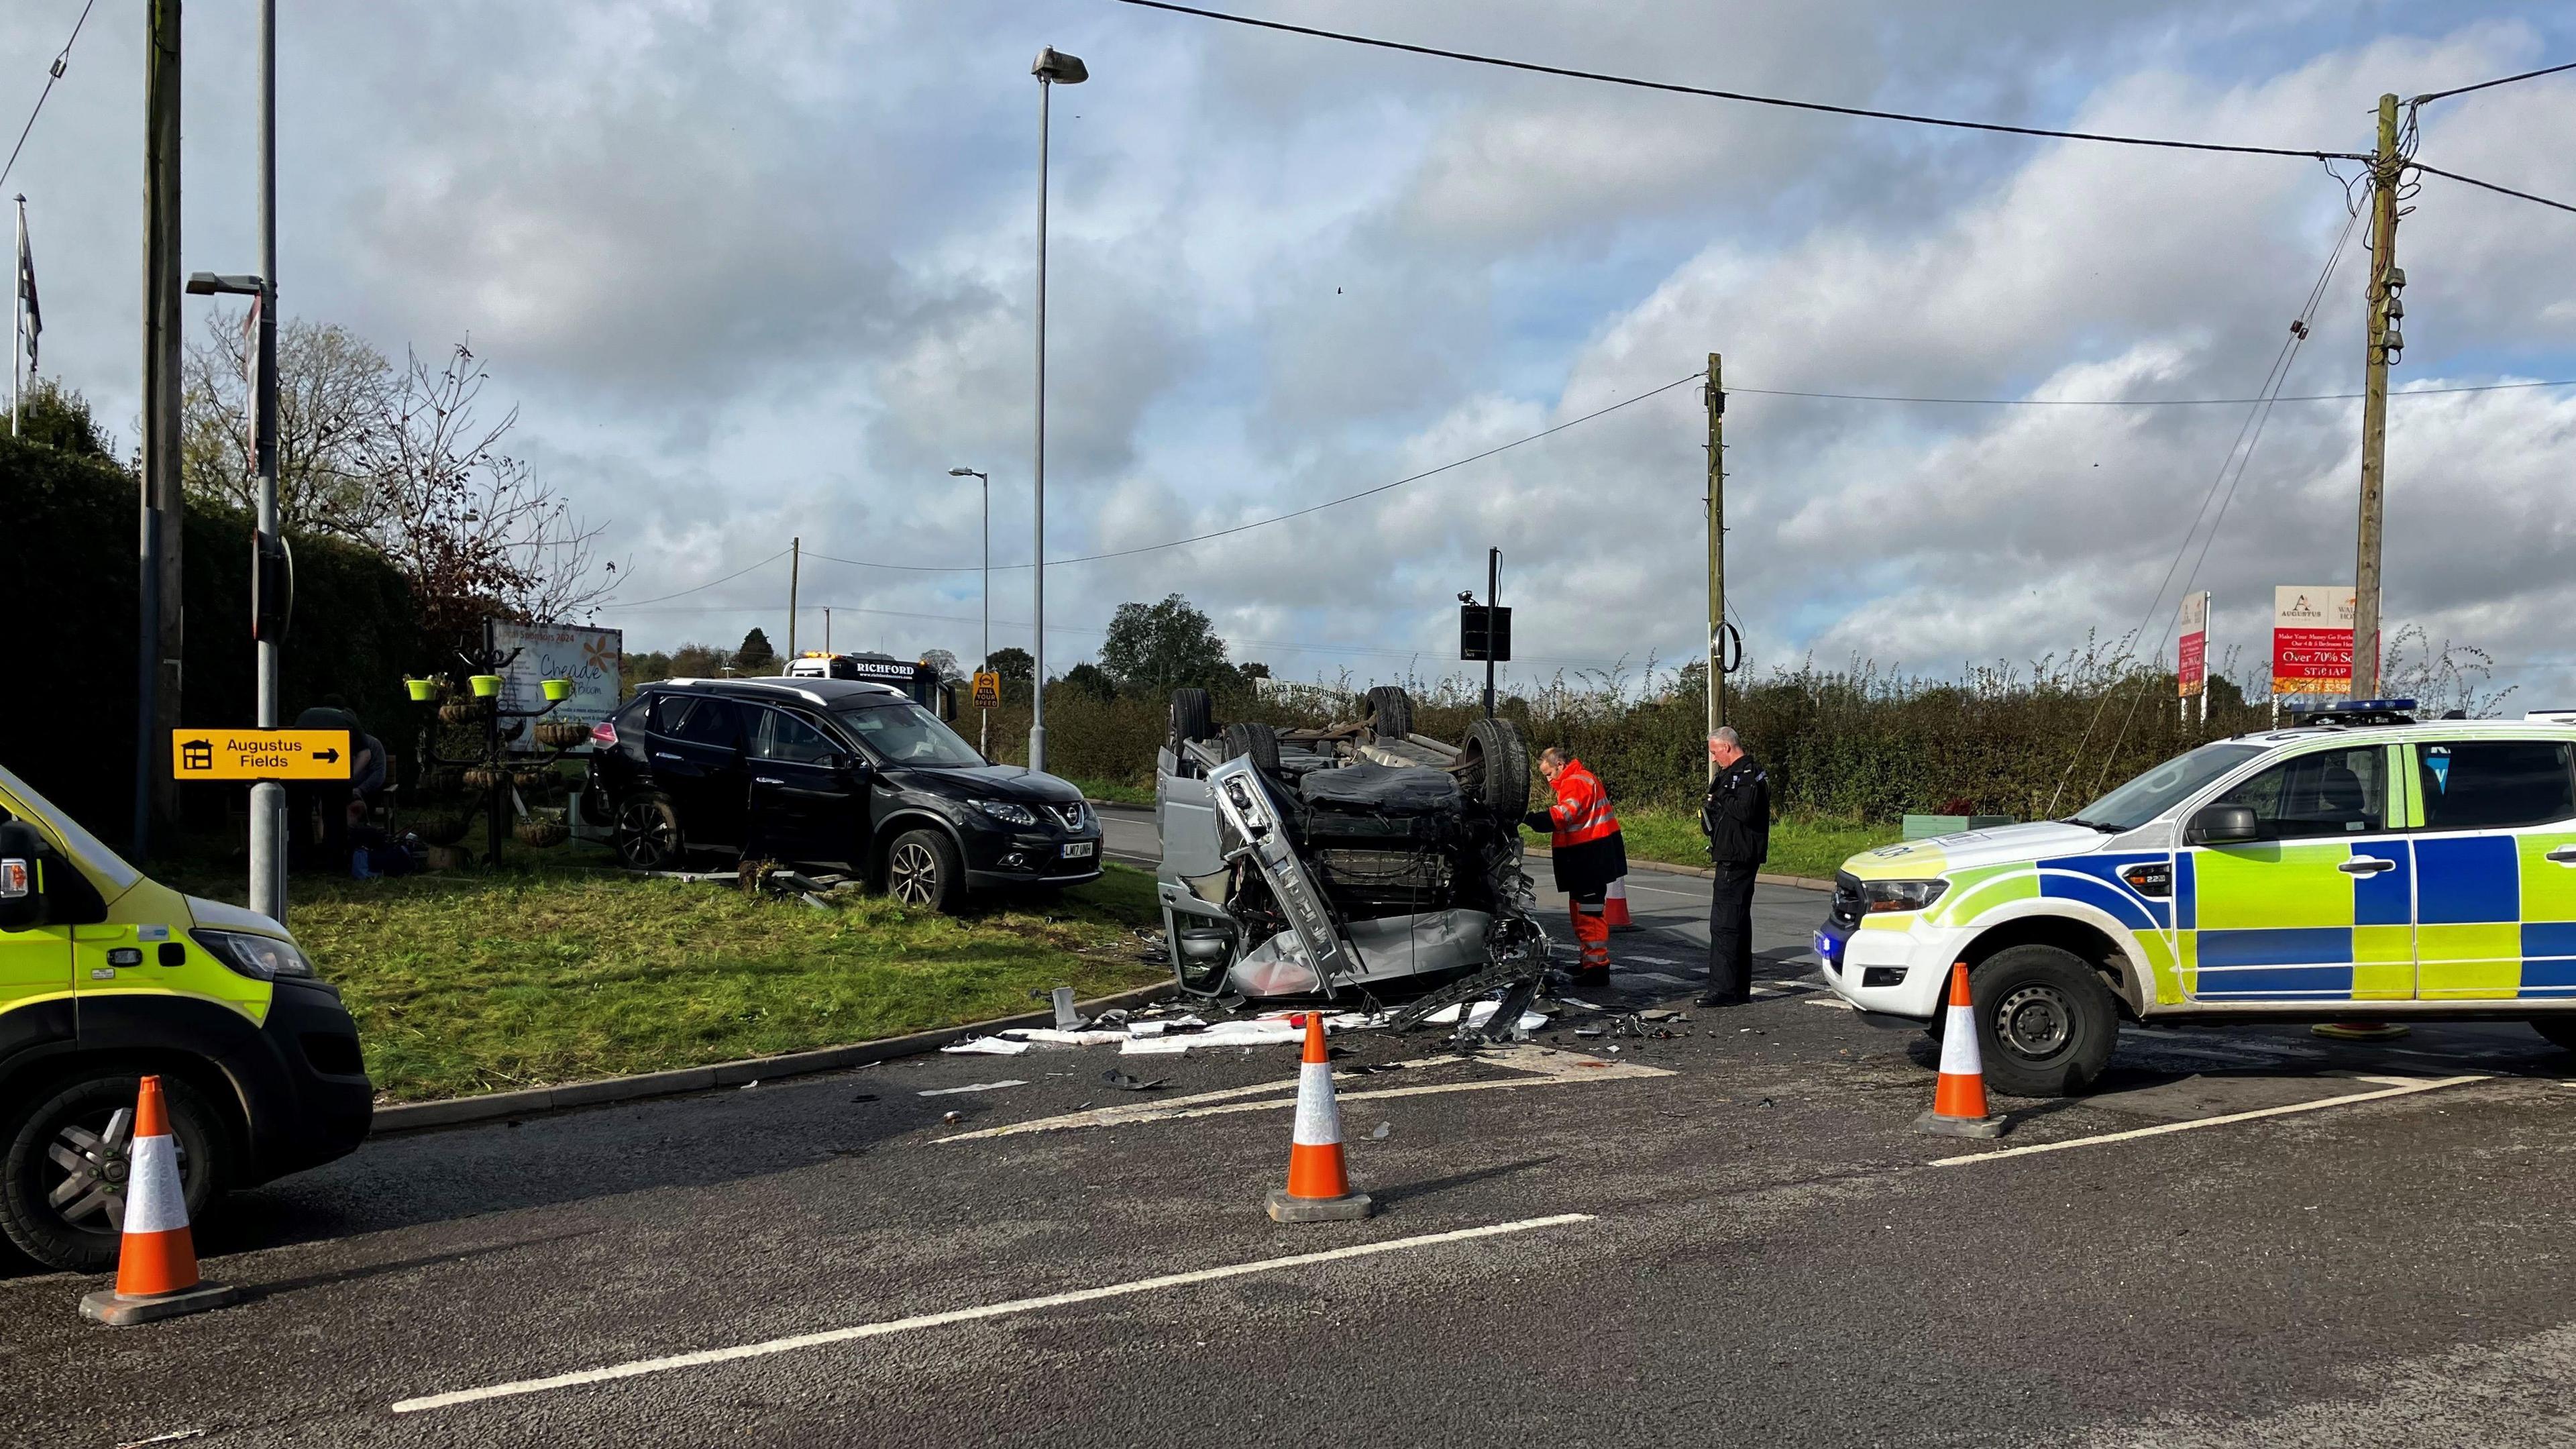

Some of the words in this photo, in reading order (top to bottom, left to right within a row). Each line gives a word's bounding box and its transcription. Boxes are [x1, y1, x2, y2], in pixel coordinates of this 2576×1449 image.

[557, 633, 574, 643] 2024
[2283, 651, 2311, 662] Over
[2314, 652, 2338, 662] 70%
[541, 654, 601, 681] Cheadle
[857, 663, 914, 675] RICHFORD
[578, 682, 602, 696] Bloom
[1290, 684, 1313, 693] HALL
[227, 739, 302, 753] Augustus
[241, 755, 288, 767] Fields
